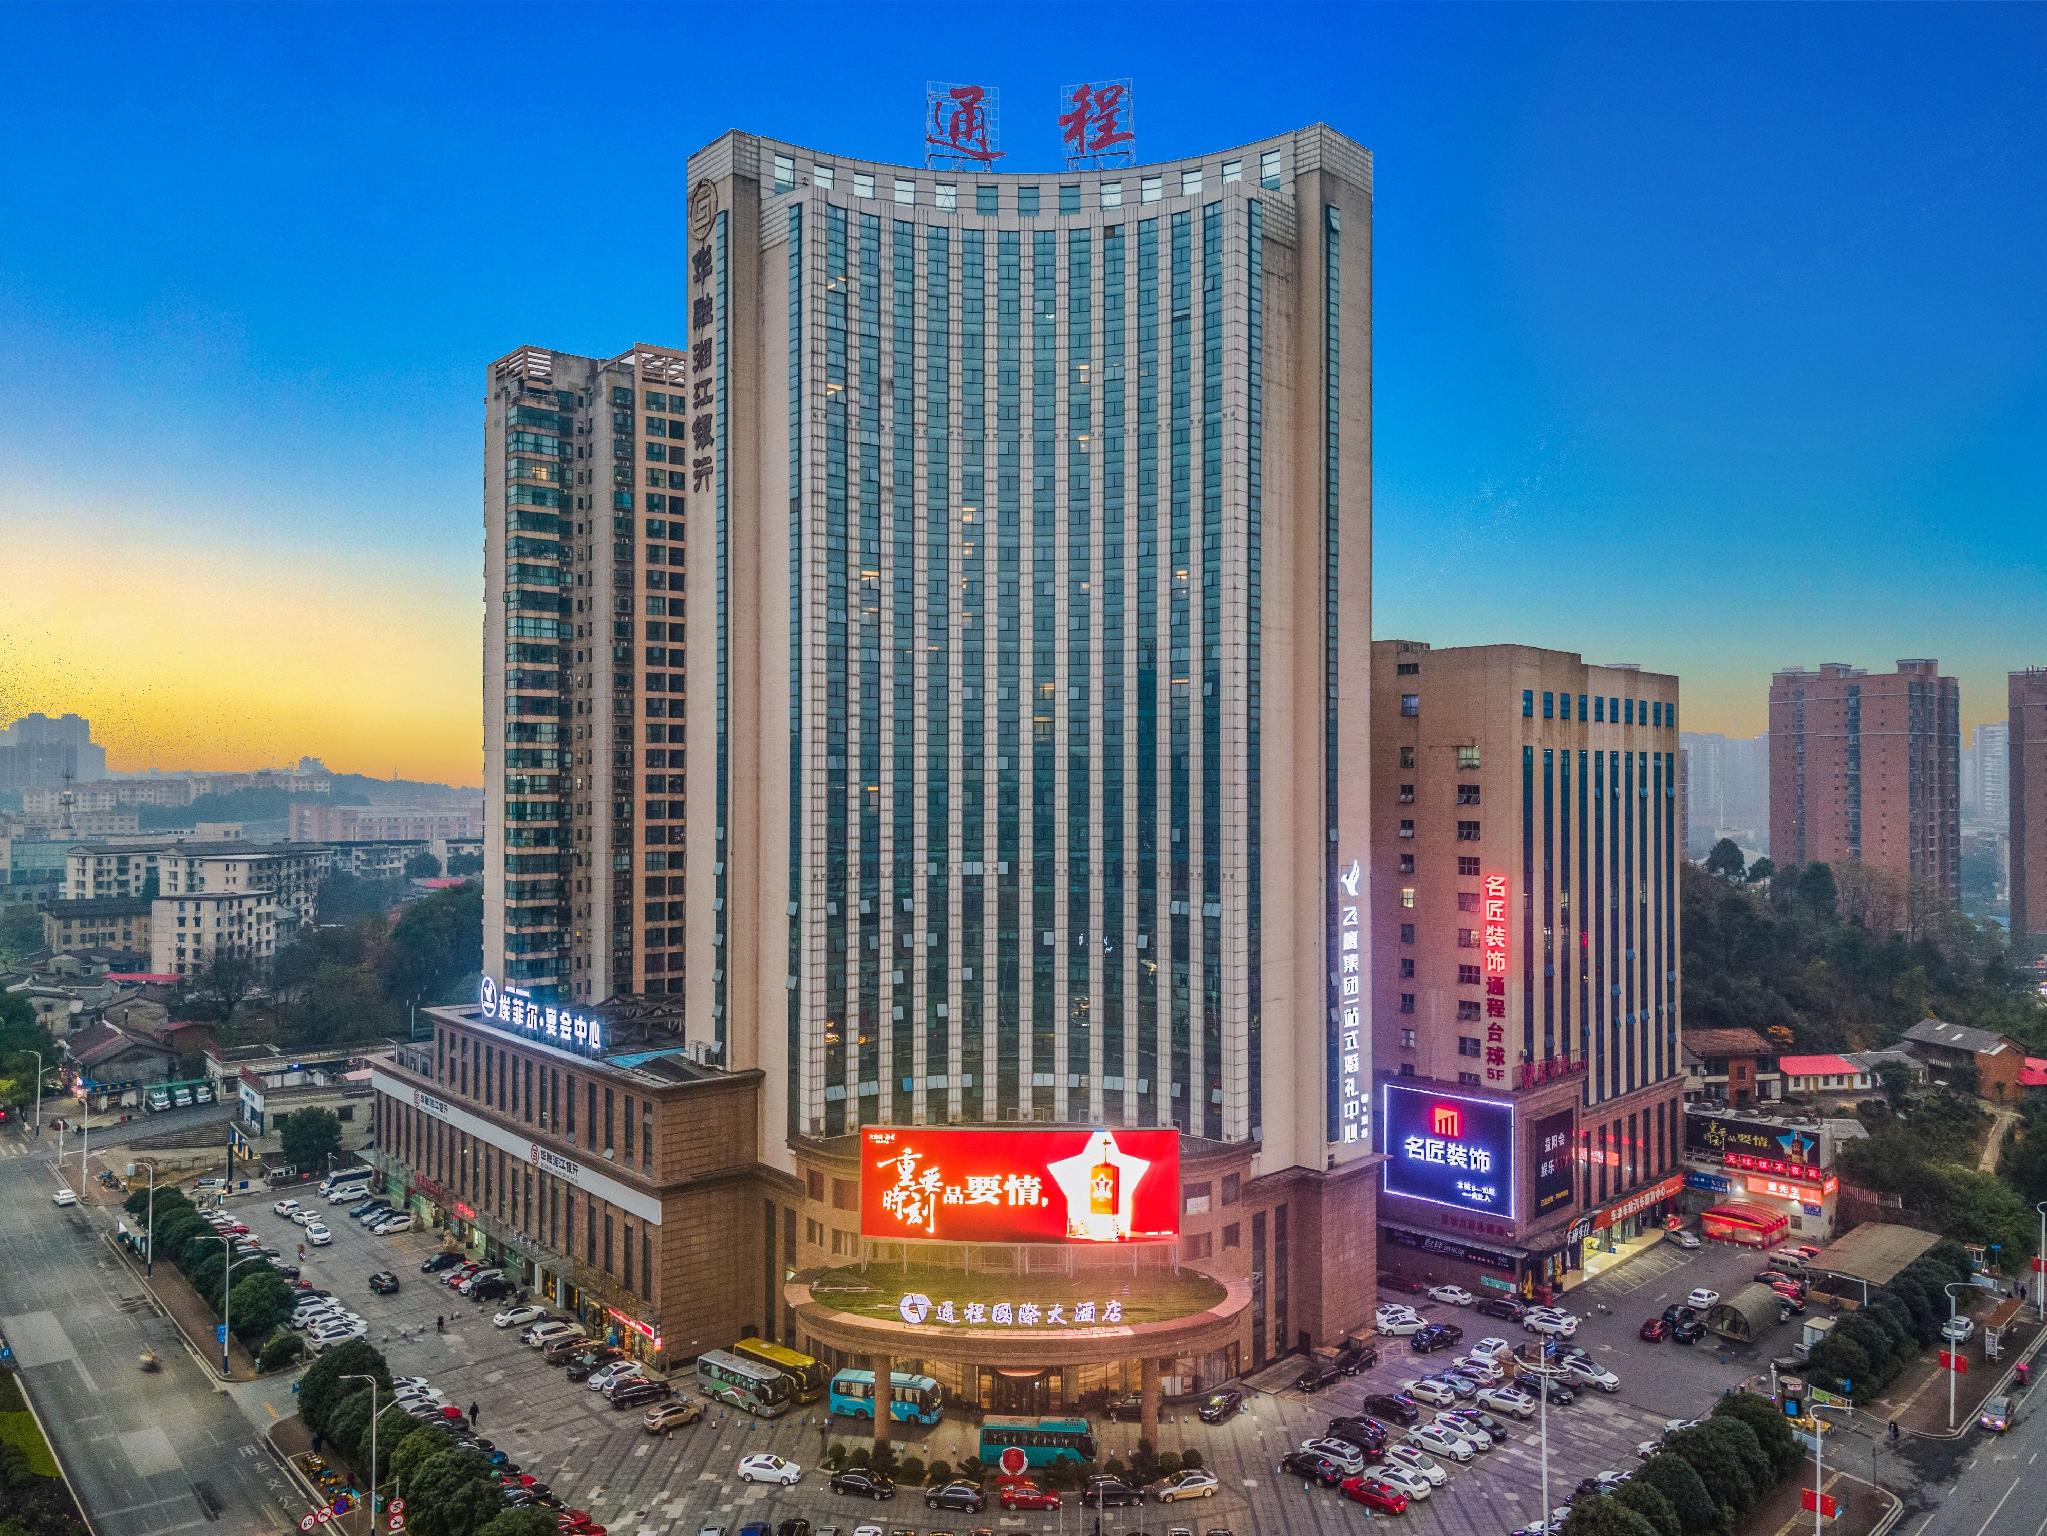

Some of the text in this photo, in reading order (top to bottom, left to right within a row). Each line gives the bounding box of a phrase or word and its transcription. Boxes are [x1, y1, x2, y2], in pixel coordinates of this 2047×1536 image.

[926, 84, 1134, 161] 通程
[1485, 875, 1506, 973] 名匠装饰
[1404, 1135, 1492, 1173] 名匠装饰
